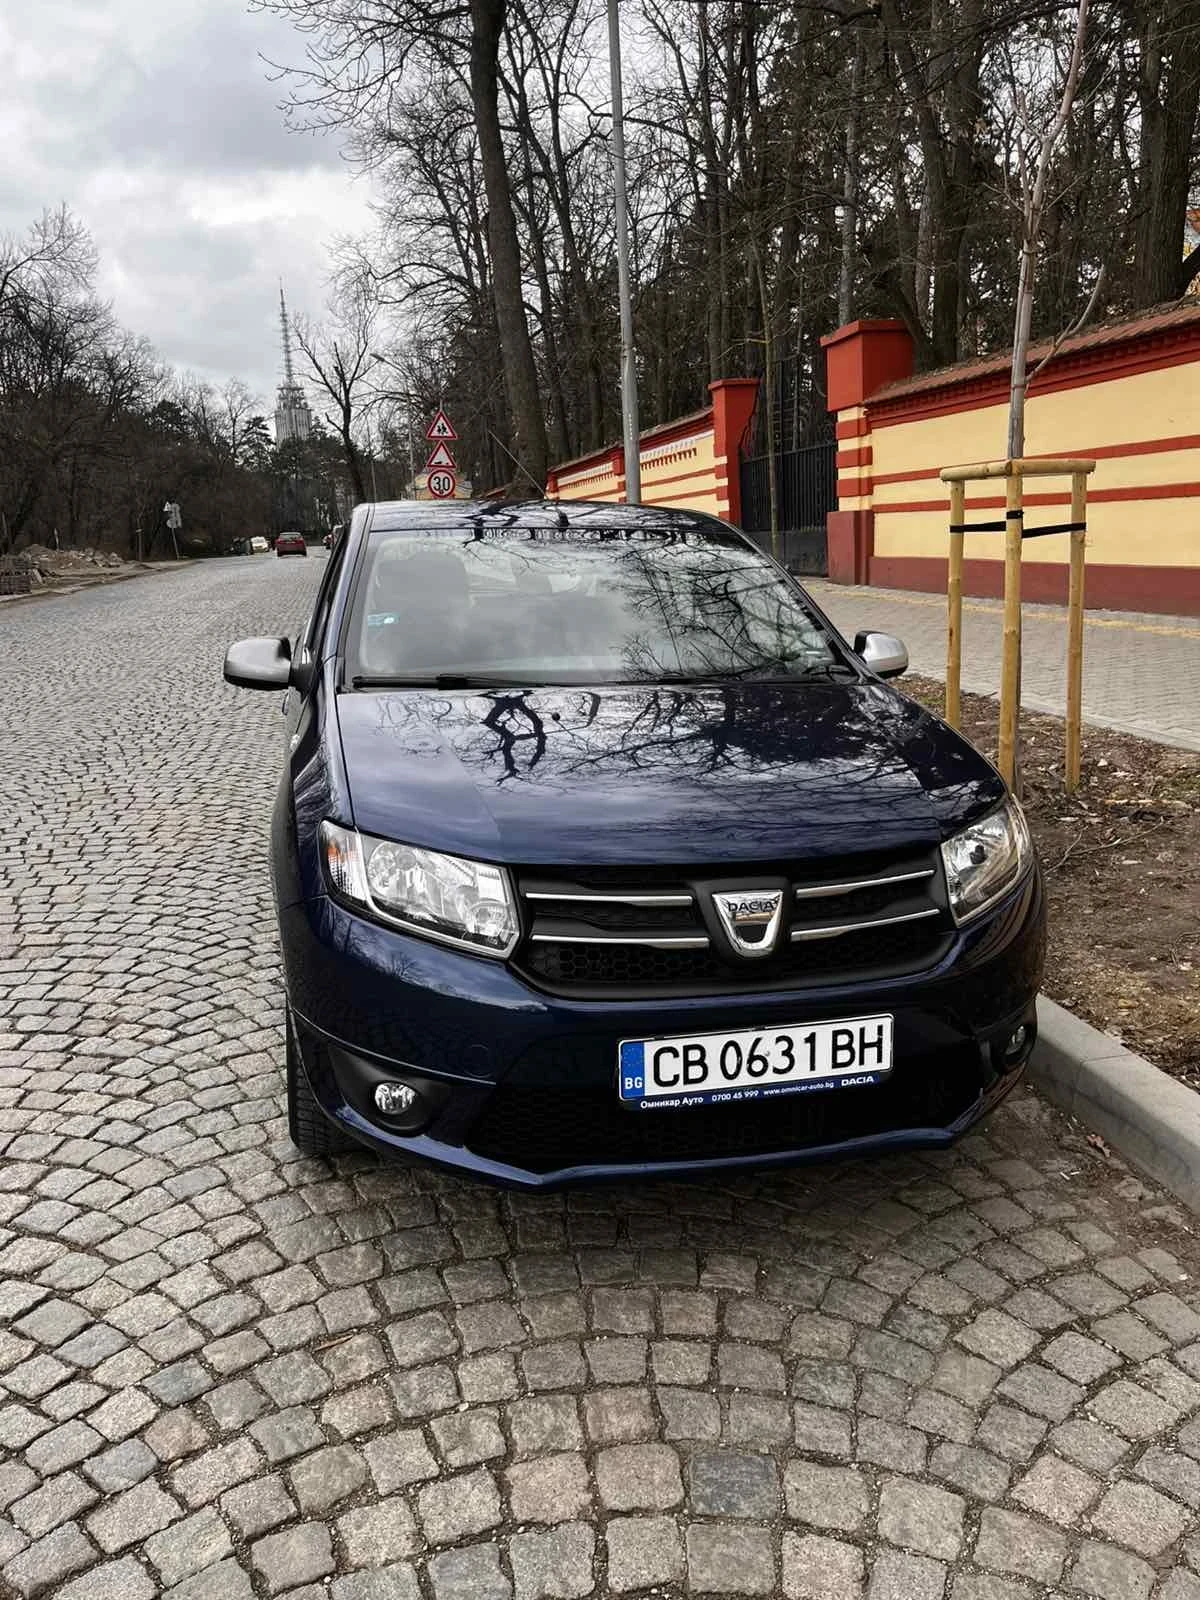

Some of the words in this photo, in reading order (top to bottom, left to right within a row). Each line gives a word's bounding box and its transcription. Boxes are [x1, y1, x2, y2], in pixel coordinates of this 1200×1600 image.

[433, 476, 450, 491] 30
[729, 901, 774, 912] DACIA
[653, 1043, 709, 1088] CB
[719, 1031, 816, 1080] 0631
[831, 1023, 884, 1069] BH
[624, 1076, 643, 1090] BG
[841, 1075, 875, 1087] DACIA
[763, 1081, 835, 1096] www.omnicar-auto.bg
[640, 1099, 681, 1109] Омникар
[682, 1096, 704, 1106] Ауто
[711, 1093, 732, 1102] 0700
